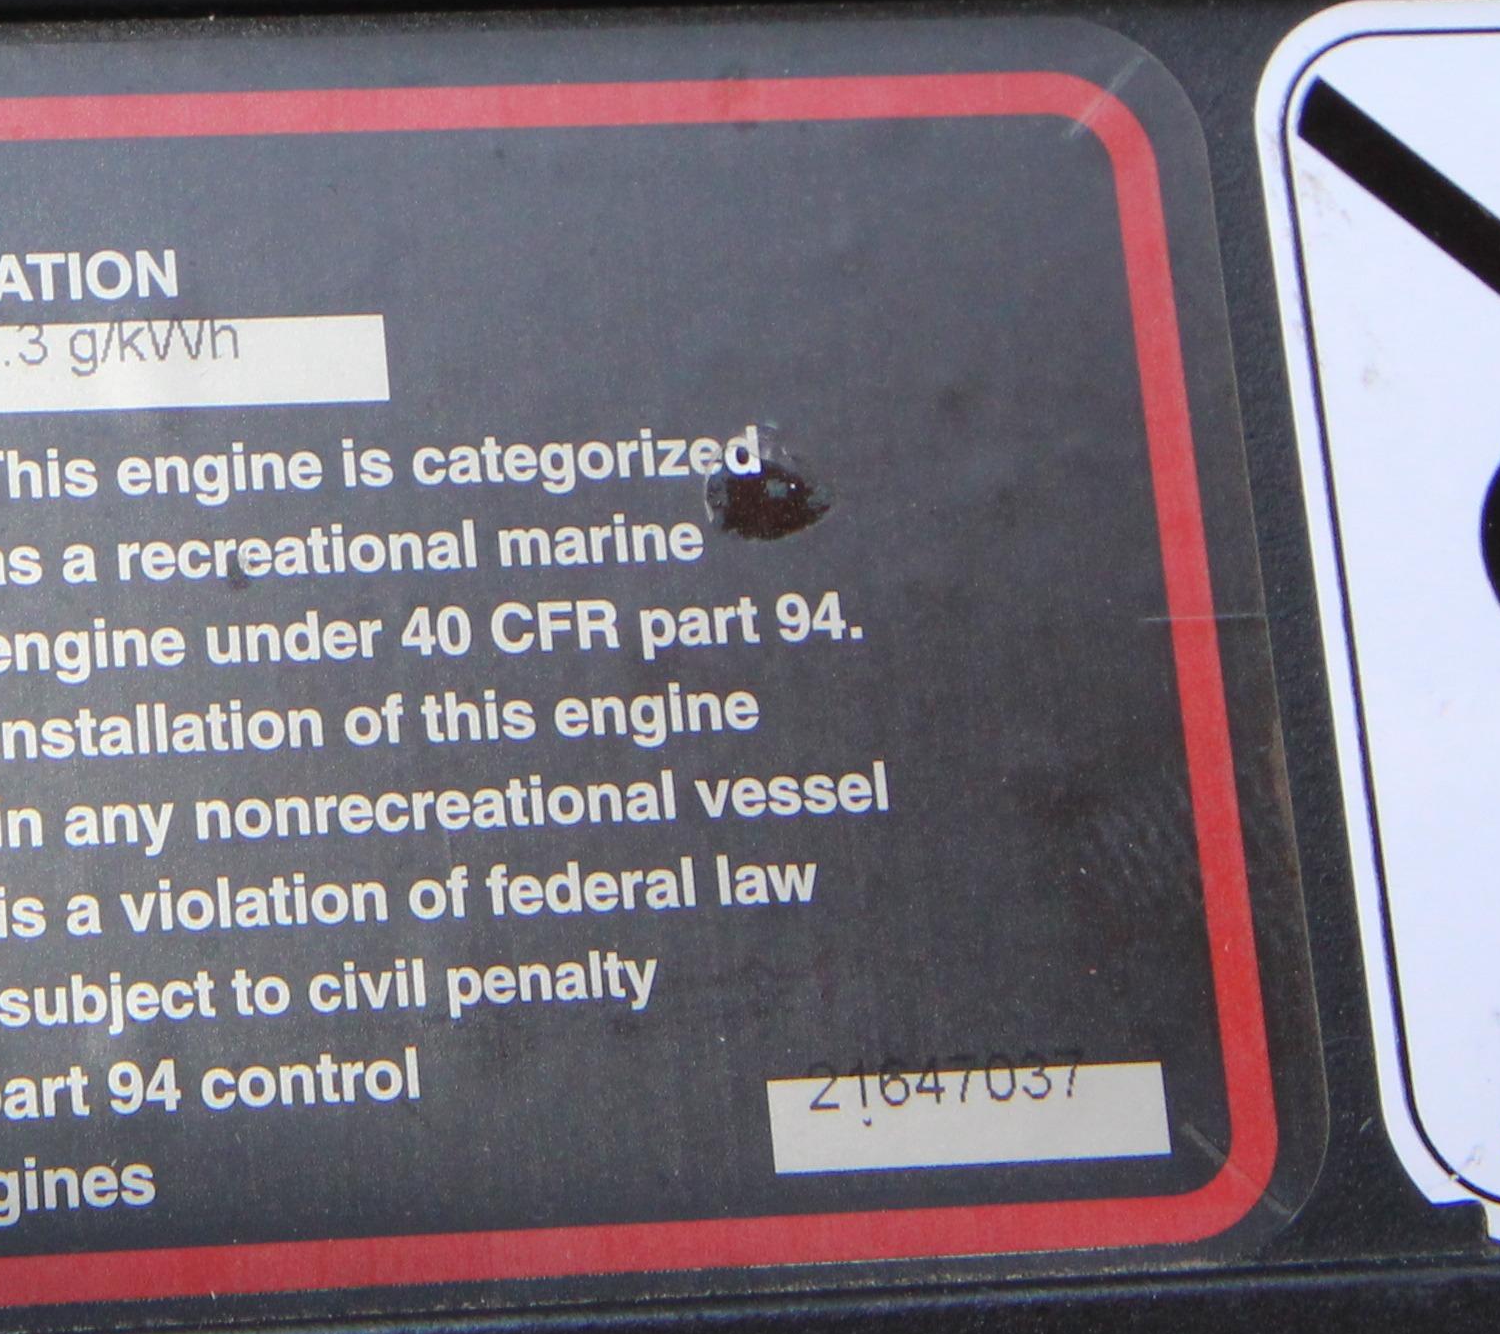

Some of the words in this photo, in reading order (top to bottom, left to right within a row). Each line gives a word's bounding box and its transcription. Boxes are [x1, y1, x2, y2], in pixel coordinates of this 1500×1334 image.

[117, 443, 322, 505] engine
[342, 439, 393, 487] is
[409, 422, 763, 489] categorized
[63, 545, 97, 583] a
[115, 517, 479, 582] recreational
[495, 513, 706, 573] marine
[206, 611, 382, 664] under
[402, 606, 471, 655] 40
[491, 600, 619, 653] CFR
[640, 597, 760, 660] part
[776, 592, 862, 641] 94.
[345, 694, 403, 745] of
[421, 690, 535, 742] this
[555, 683, 758, 747] engine
[65, 803, 173, 856] any
[195, 770, 675, 840] nonrecreational
[695, 761, 888, 817] vessel
[67, 895, 102, 935] a
[120, 874, 387, 932] violation
[409, 866, 468, 919] of
[486, 857, 695, 915] federal
[717, 855, 816, 905] law
[0, 972, 216, 1035] subject
[231, 970, 290, 1015] to
[309, 959, 426, 1012] civil
[447, 951, 656, 1018] penalty
[108, 1060, 181, 1113] 94
[202, 1047, 419, 1109] control
[808, 1049, 1084, 1111] 21647037
